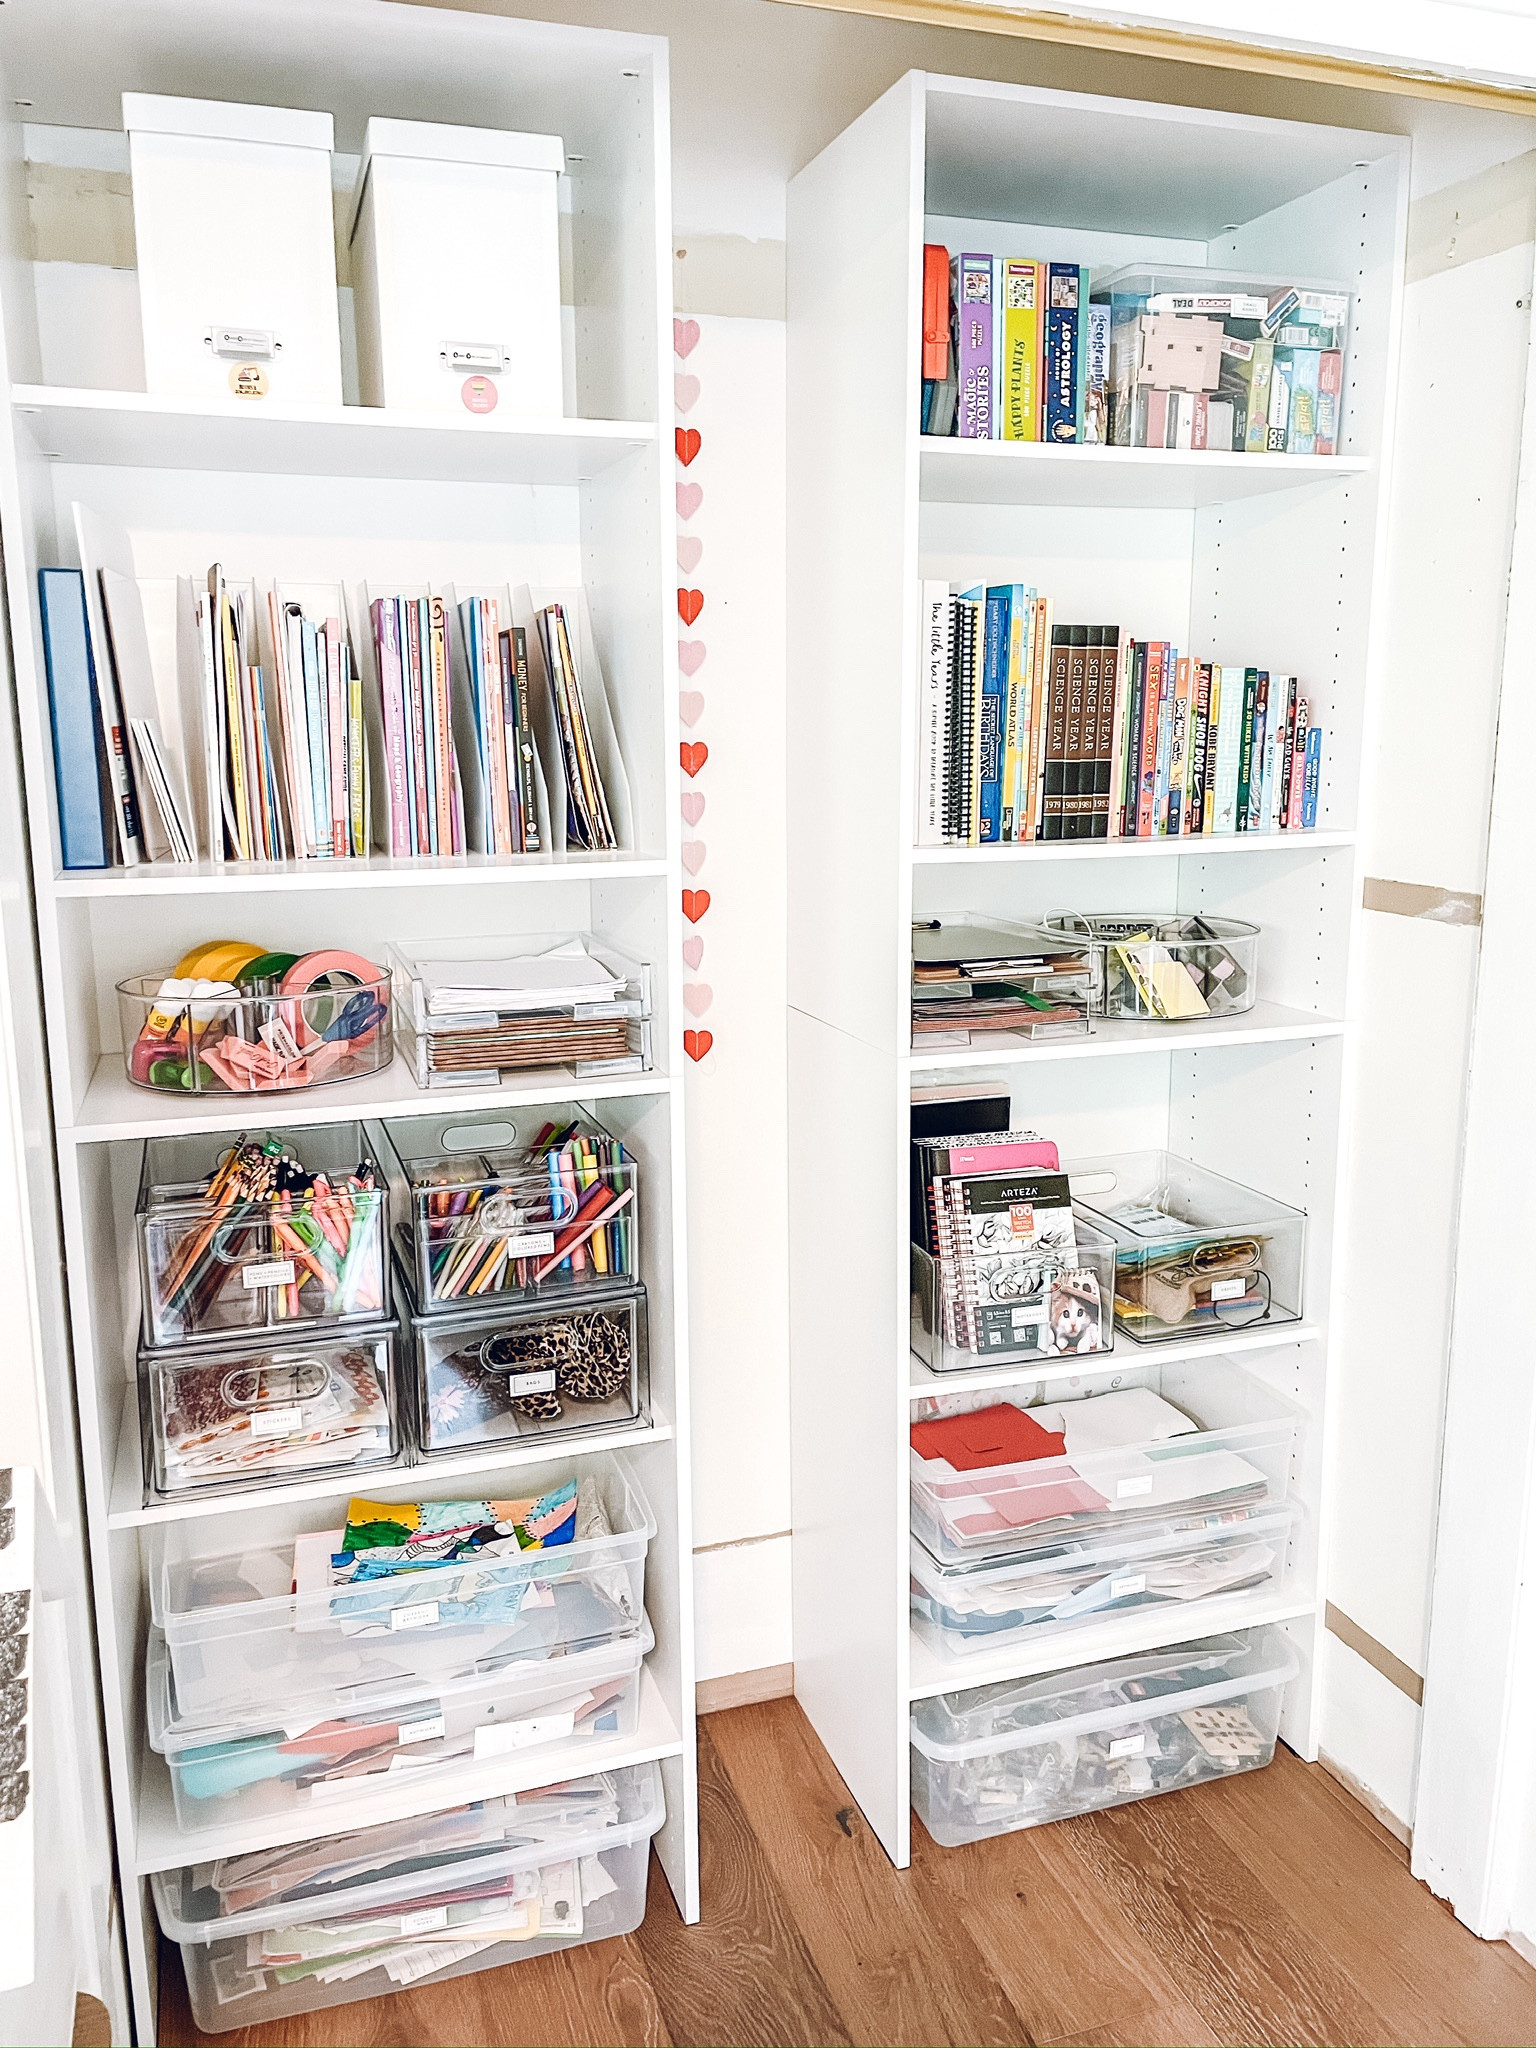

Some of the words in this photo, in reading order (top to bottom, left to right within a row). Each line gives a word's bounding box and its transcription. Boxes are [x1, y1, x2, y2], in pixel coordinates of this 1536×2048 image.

[1173, 299, 1193, 308] DEAL
[1011, 338, 1026, 392] PLANTS
[1060, 321, 1072, 408] ASTROLOGY
[1091, 313, 1107, 391] geography
[964, 378, 977, 425] MAGIC
[977, 366, 989, 440] STORIES
[1011, 396, 1024, 440] HAPPY
[1269, 428, 1277, 450] 100
[931, 602, 943, 623] The
[517, 660, 528, 691] MONEY
[930, 660, 941, 689] Years
[1055, 658, 1065, 713] SCIENCE
[1071, 658, 1083, 714] SCIENCE
[1086, 658, 1099, 713] SCIENCE
[1102, 658, 1113, 713] SCIENCE
[1149, 665, 1160, 690] SEX
[1009, 682, 1018, 717] WORLD
[1176, 697, 1188, 718] DOG
[1197, 670, 1210, 715] KNIGHT
[980, 699, 991, 778] BIRTHDAYS
[1007, 719, 1015, 747] ATLAS
[1053, 718, 1062, 751] YEAR
[1069, 718, 1080, 751] YEAR
[1085, 718, 1095, 751] YEAR
[1101, 718, 1111, 751] YEAR
[1174, 719, 1186, 737] MAN
[1195, 717, 1207, 747] SHOE
[1208, 725, 1218, 751] KOBE
[1145, 734, 1155, 767] WORD
[1194, 748, 1205, 772] DOG
[1243, 745, 1251, 764] WITH
[1285, 738, 1293, 755] BAD
[1206, 753, 1217, 792] BRYANT
[1045, 800, 1061, 809] 1979
[1063, 801, 1078, 809] 1980
[1078, 800, 1092, 808] 1981
[1001, 1187, 1038, 1198] ARTEZA
[1011, 1206, 1032, 1217] 100
